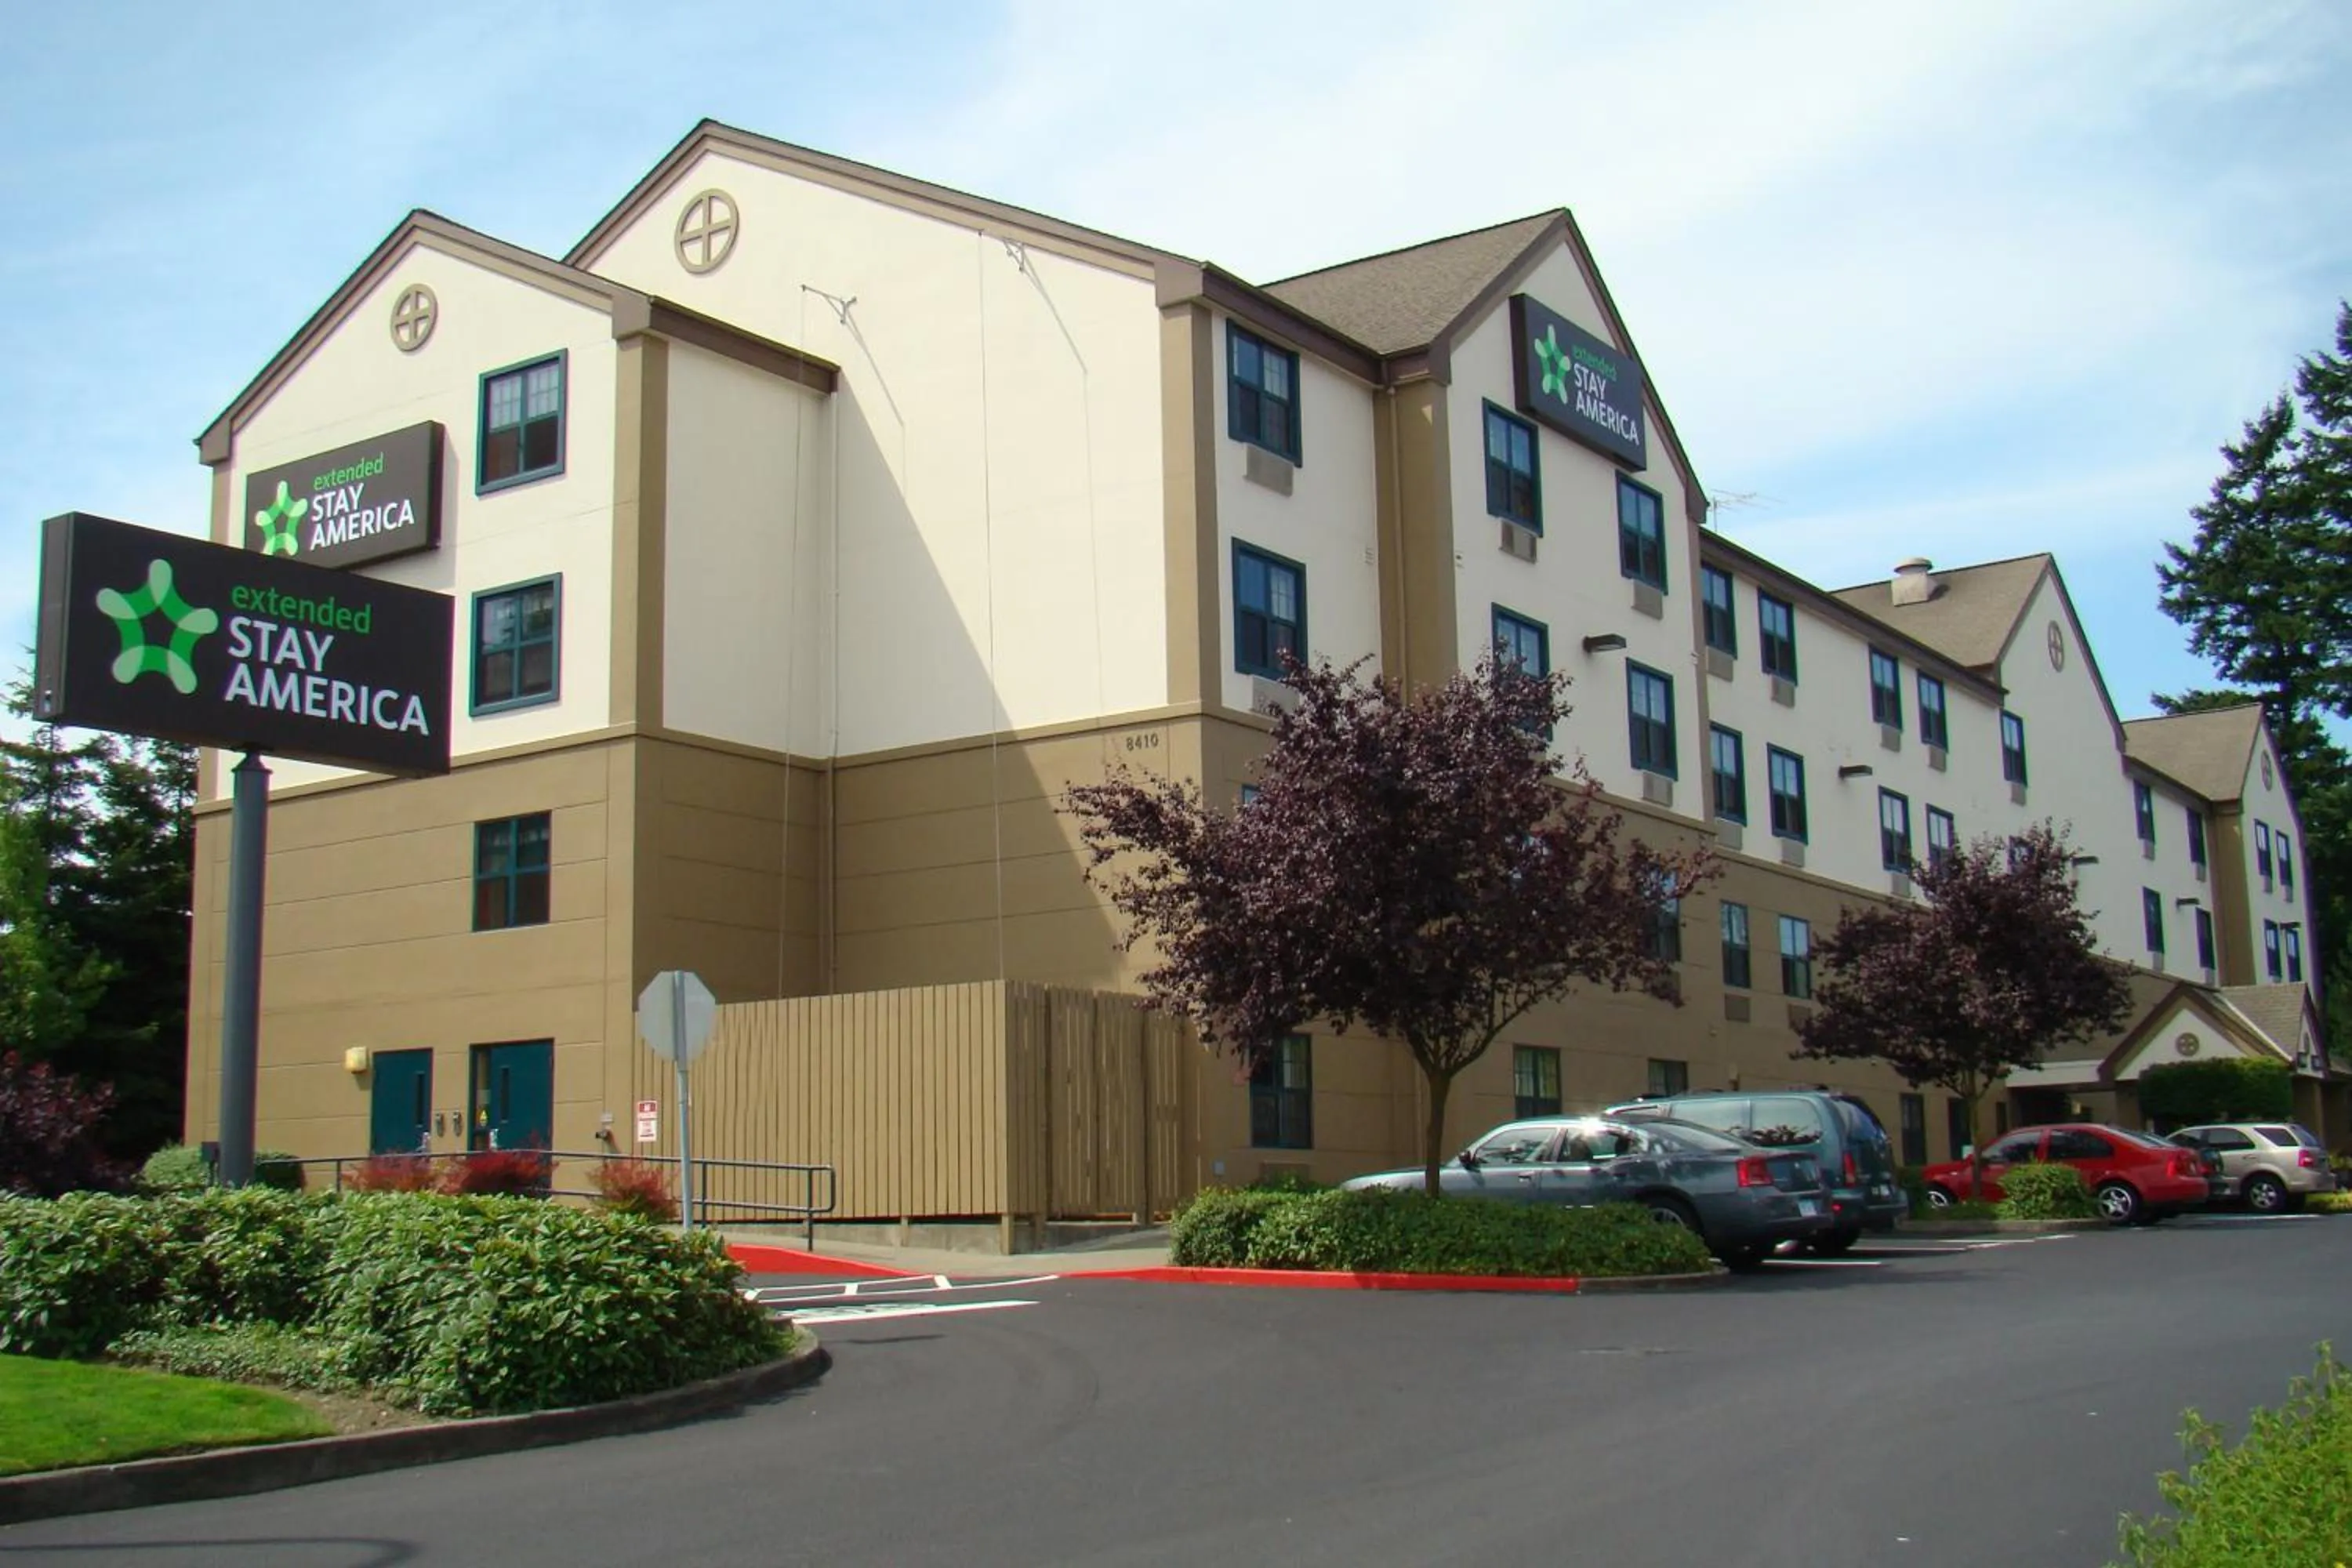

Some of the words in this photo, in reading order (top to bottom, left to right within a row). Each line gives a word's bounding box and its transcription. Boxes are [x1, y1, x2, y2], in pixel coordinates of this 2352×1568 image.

[1572, 345, 1617, 381] extended
[1573, 363, 1606, 398] STAY
[1575, 391, 1639, 445] AMERICA
[314, 452, 383, 490] extended
[310, 499, 415, 550] AMERICA
[311, 483, 365, 523] STAY
[230, 585, 372, 634] extended
[227, 616, 334, 671] STAY
[224, 662, 430, 735] AMERICA
[1126, 732, 1159, 751] 8410
